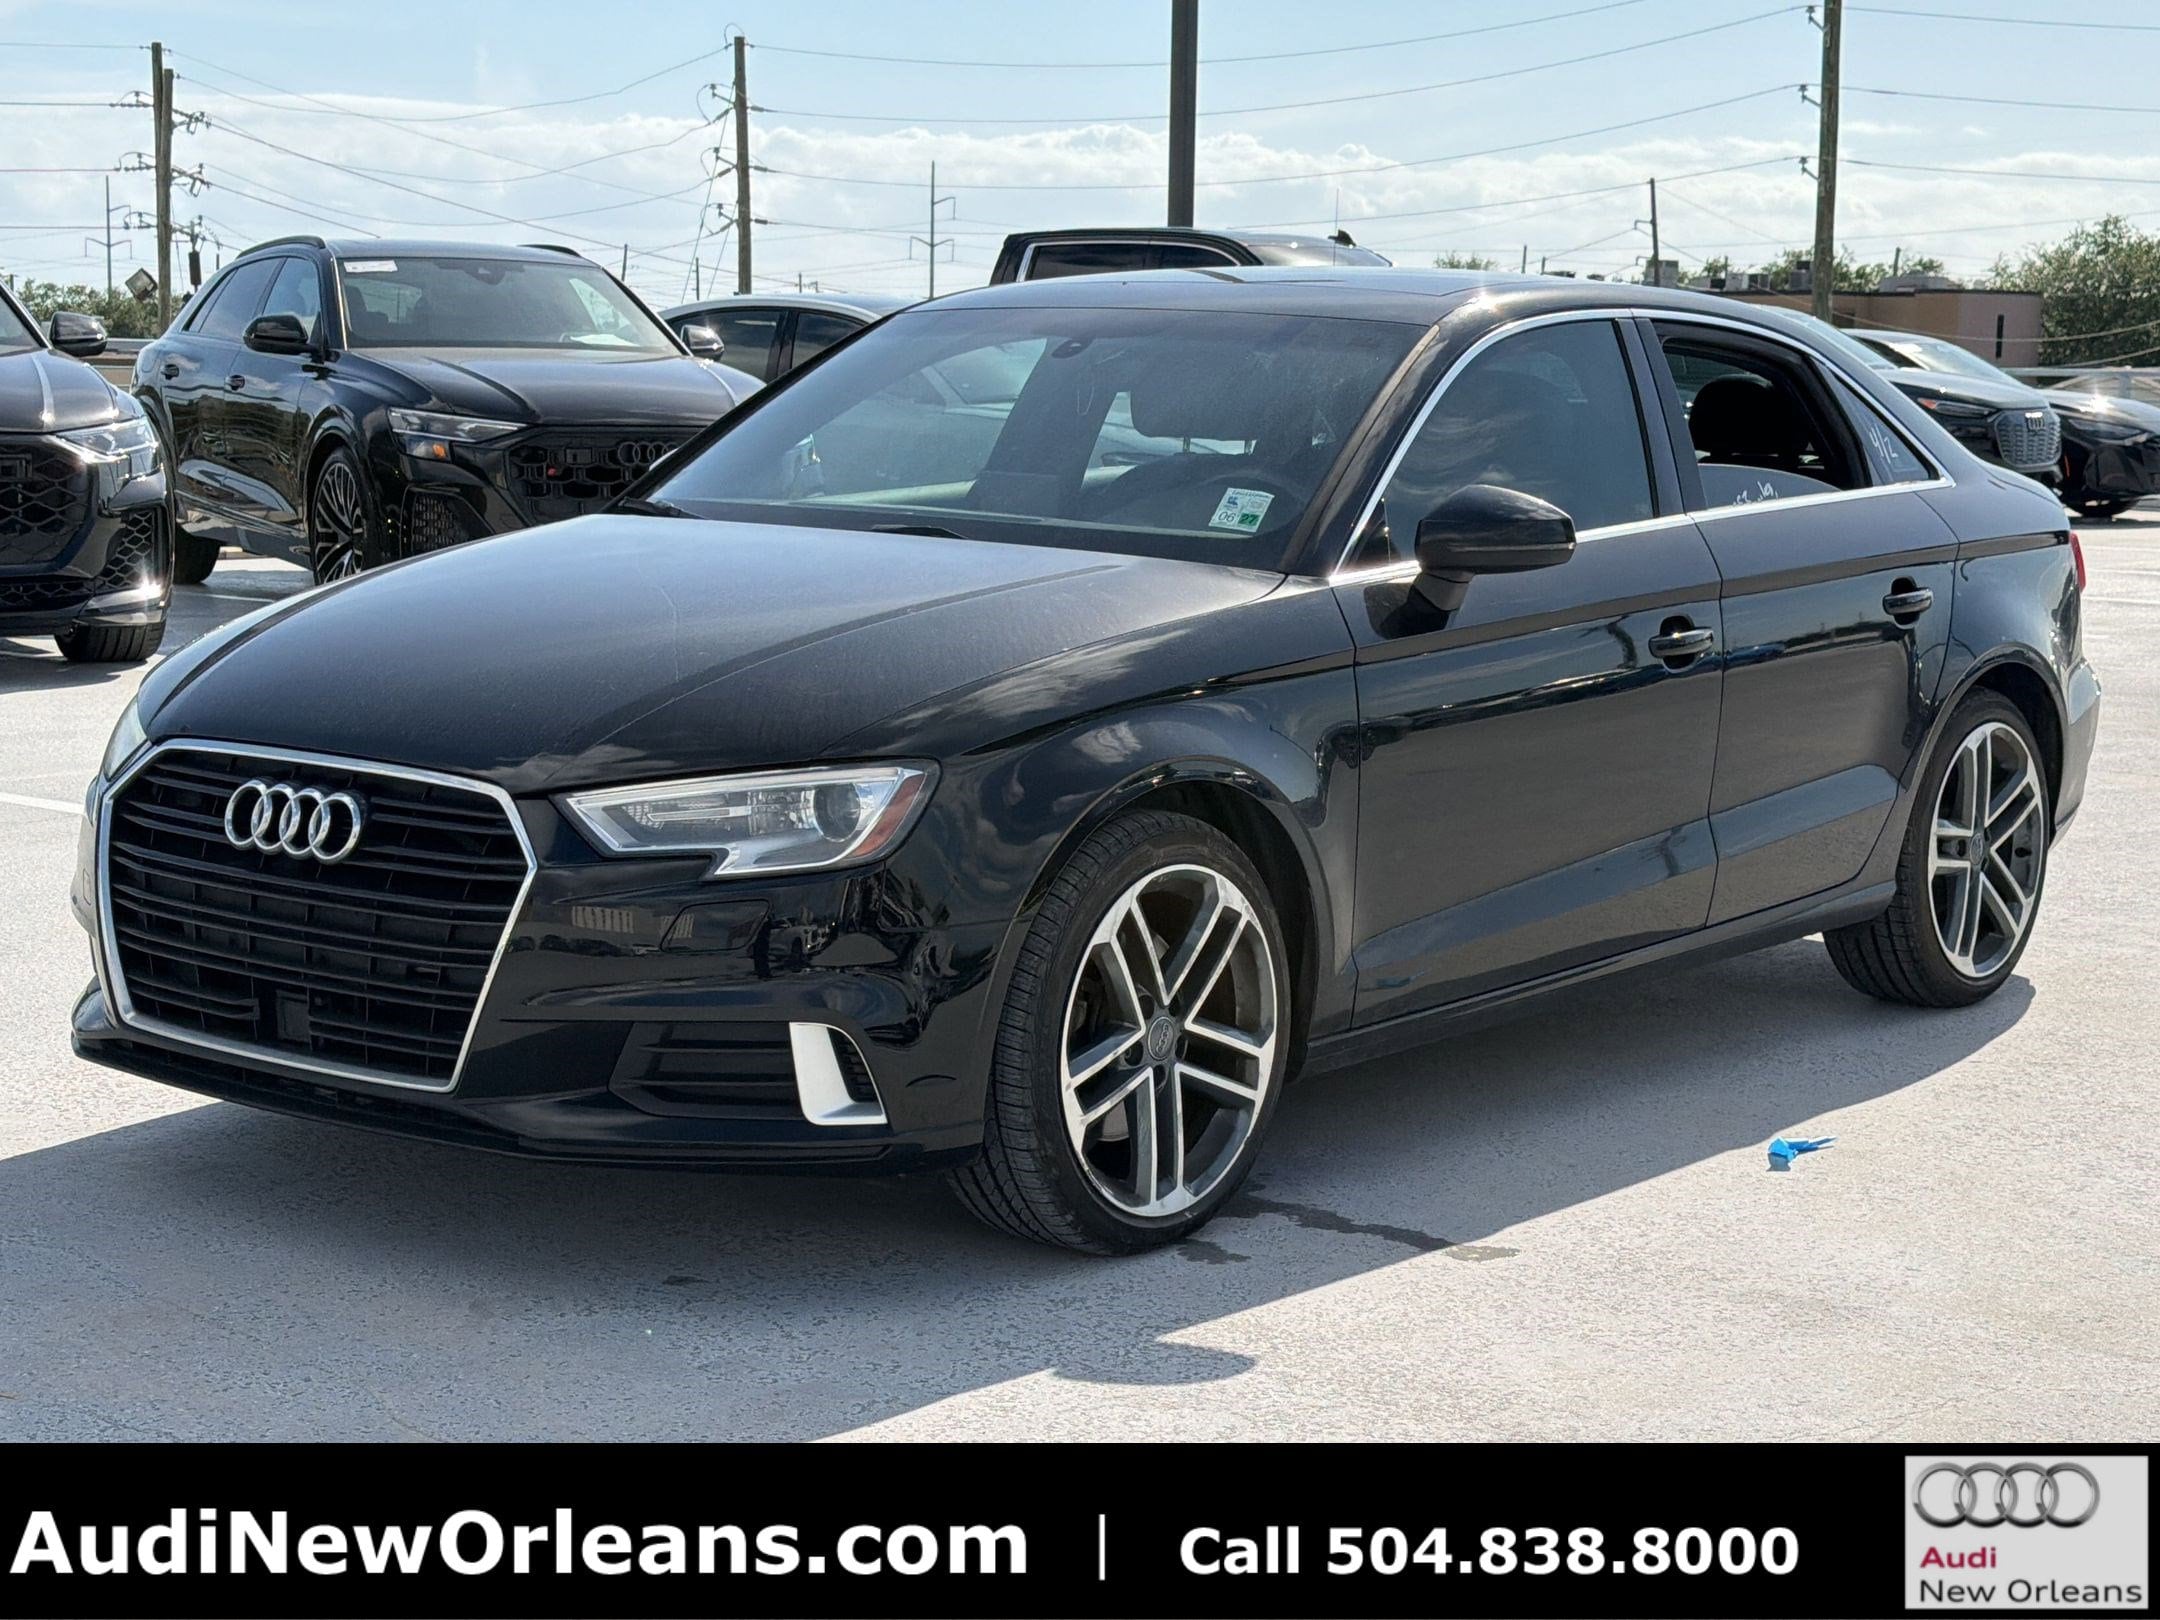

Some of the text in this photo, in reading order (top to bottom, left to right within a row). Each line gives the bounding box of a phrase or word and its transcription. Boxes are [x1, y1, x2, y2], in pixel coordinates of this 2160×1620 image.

[1869, 423, 1899, 464] 4/2
[1218, 511, 1258, 524] 06 27
